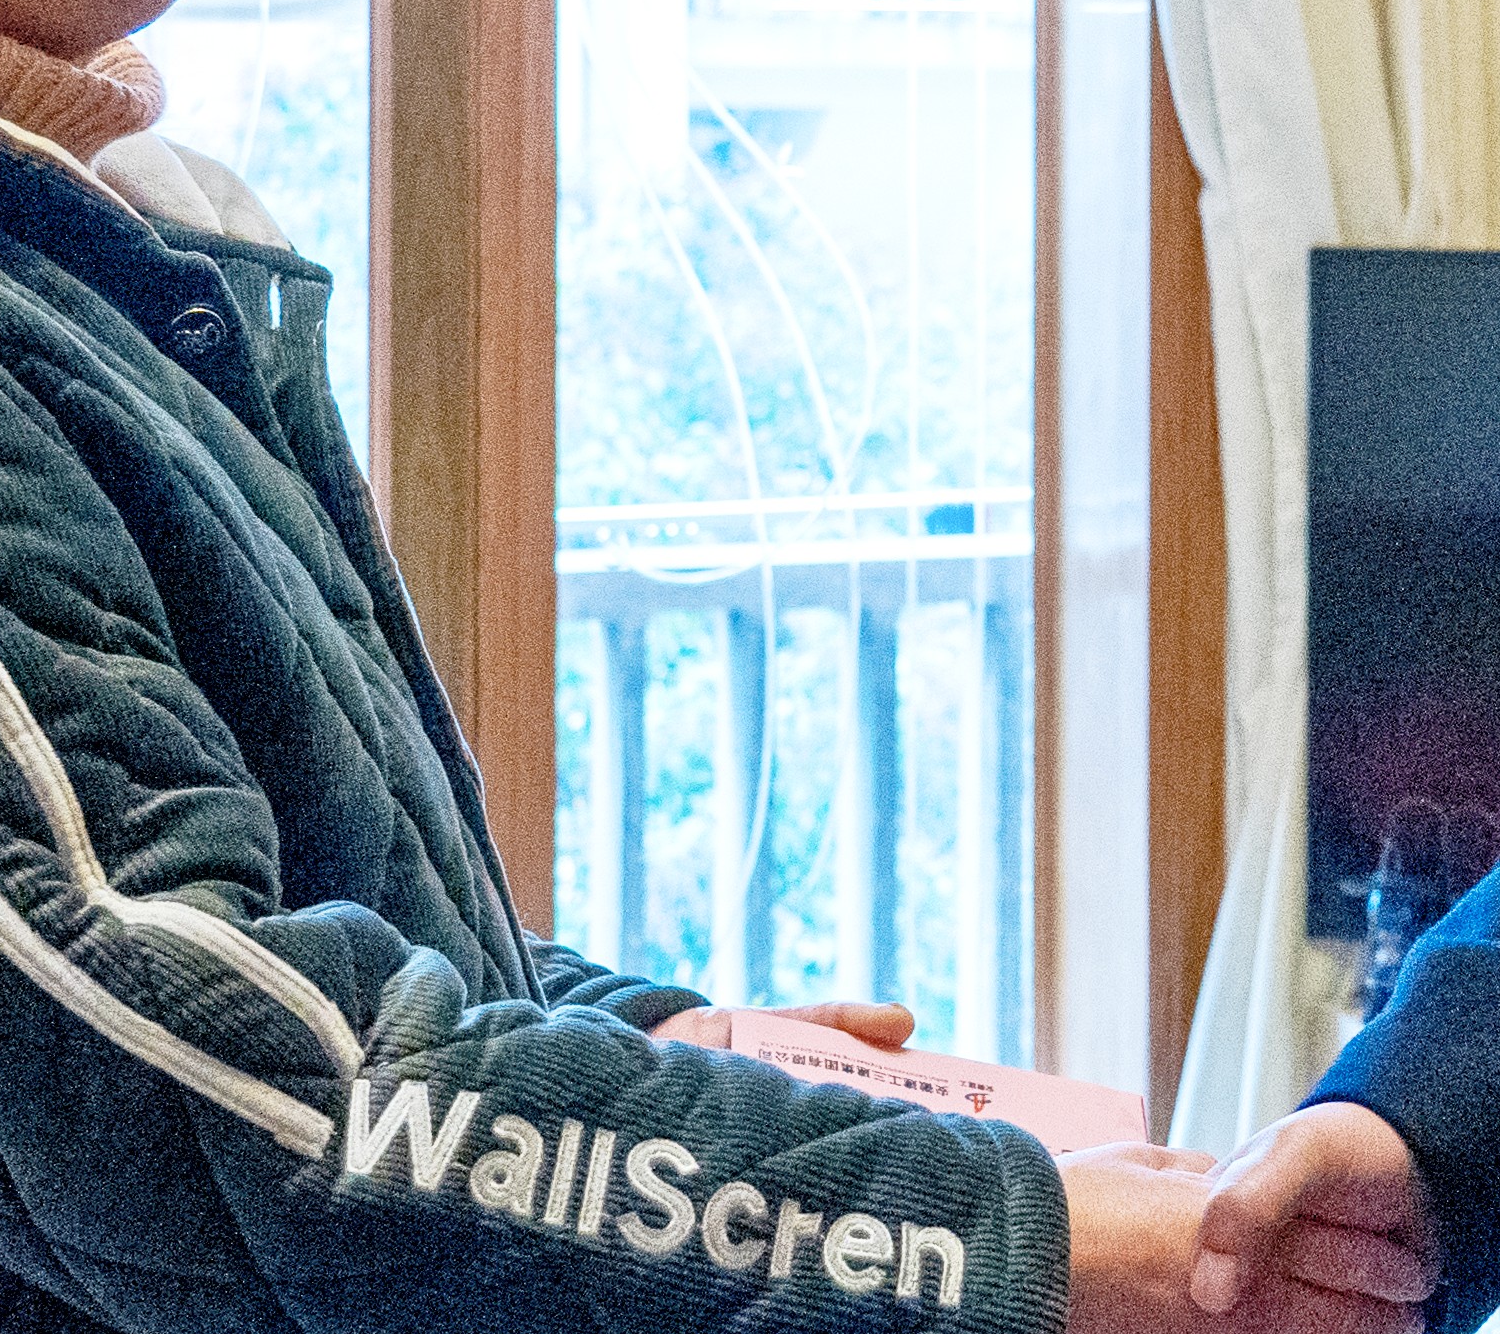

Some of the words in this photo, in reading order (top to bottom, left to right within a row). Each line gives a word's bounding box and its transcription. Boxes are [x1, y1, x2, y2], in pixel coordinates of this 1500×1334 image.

[758, 1049, 949, 1097] 安徽建工三建集团有限公司
[345, 1078, 965, 1307] WallScren
